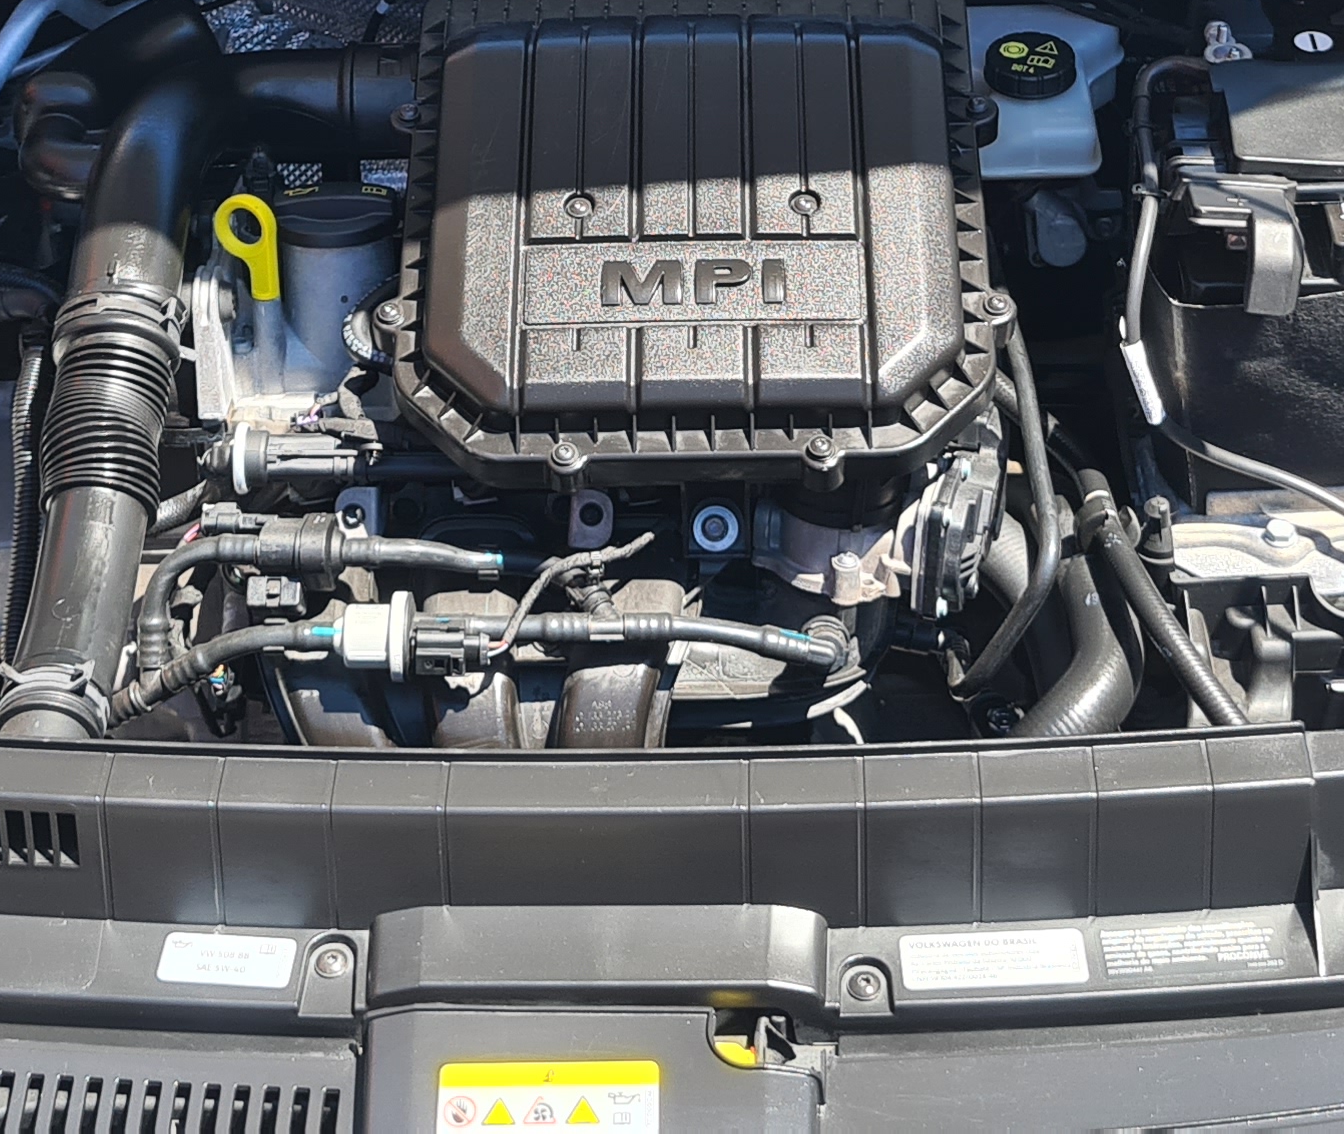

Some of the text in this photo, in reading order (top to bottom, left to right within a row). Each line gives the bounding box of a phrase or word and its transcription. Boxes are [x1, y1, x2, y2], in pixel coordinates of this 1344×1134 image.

[1011, 63, 1027, 72] DOT
[601, 259, 785, 306] MPI
[908, 937, 1037, 949] VOLKSWAGEN DO BRASIL
